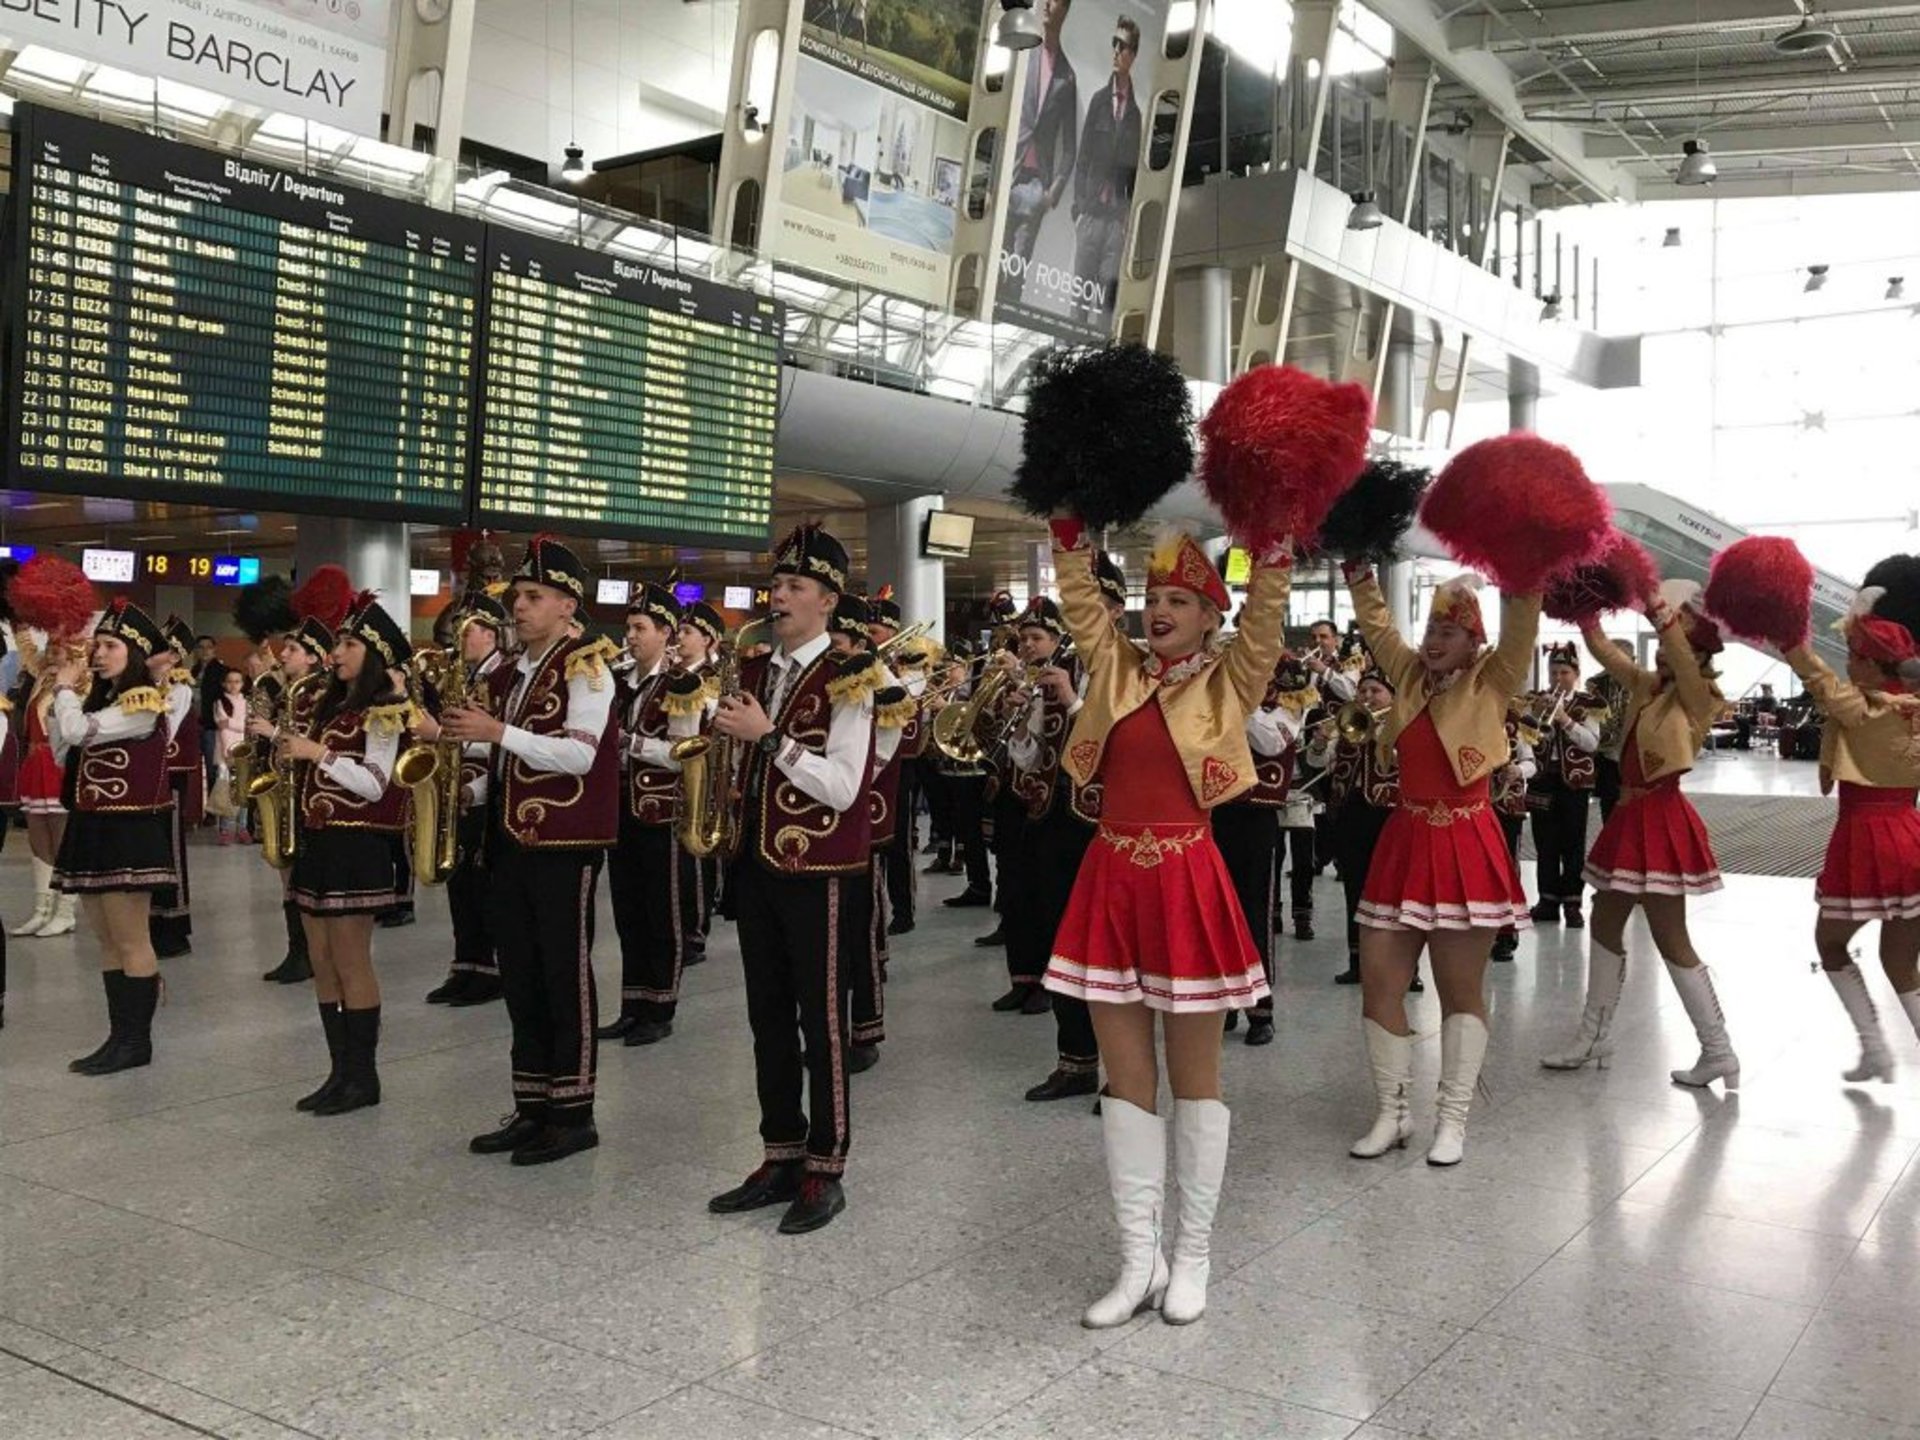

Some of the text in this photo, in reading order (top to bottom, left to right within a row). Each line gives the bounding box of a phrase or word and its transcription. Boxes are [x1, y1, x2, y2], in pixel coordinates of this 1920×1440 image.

[167, 21, 356, 107] BARCLAY
[32, 185, 70, 206] 13:55
[33, 164, 70, 185] 13:00
[279, 221, 328, 243] Check-in
[284, 175, 344, 206] Departure
[30, 227, 68, 246] 15:20
[276, 276, 325, 297] Check-in
[31, 206, 69, 226] 15:10
[175, 236, 188, 251] El
[277, 258, 326, 279] Check-in
[28, 268, 66, 287] 16:00
[131, 287, 174, 306] Vienna
[274, 313, 323, 332] Check-in
[29, 248, 67, 267] 15:45
[275, 295, 324, 314] Check-in
[652, 269, 692, 294] Departure
[999, 249, 1107, 304] ROY ROBSON
[26, 309, 64, 328] 17:50
[129, 326, 158, 342] Kyiv
[272, 350, 326, 369] Scheduled
[27, 289, 65, 307] 17:25
[130, 307, 173, 325] Milano
[273, 331, 327, 351] Scheduled
[24, 351, 62, 368] 19:50
[69, 357, 106, 374] PC421
[128, 366, 181, 385] Istanbul
[270, 386, 324, 404] Scheduled
[25, 330, 63, 348] 18:15
[128, 346, 171, 364] Warsaw
[271, 368, 325, 387] Scheduled
[22, 392, 60, 408] 22:10
[126, 405, 179, 423] Istanbul
[268, 423, 322, 440] Scheduled
[23, 371, 61, 388] 20:35
[68, 377, 113, 395] FR5379
[269, 404, 323, 422] Scheduled
[20, 433, 58, 449] 01:40
[21, 412, 59, 429] 23:10
[166, 429, 224, 447] Fiumicino
[267, 441, 321, 457] Scheduled
[20, 453, 57, 468] 03:05
[122, 463, 158, 478] Sharm
[164, 467, 177, 479] El
[183, 469, 223, 484] Sheikh
[147, 555, 167, 573] 18
[189, 558, 210, 576] 19
[755, 590, 768, 603] 24
